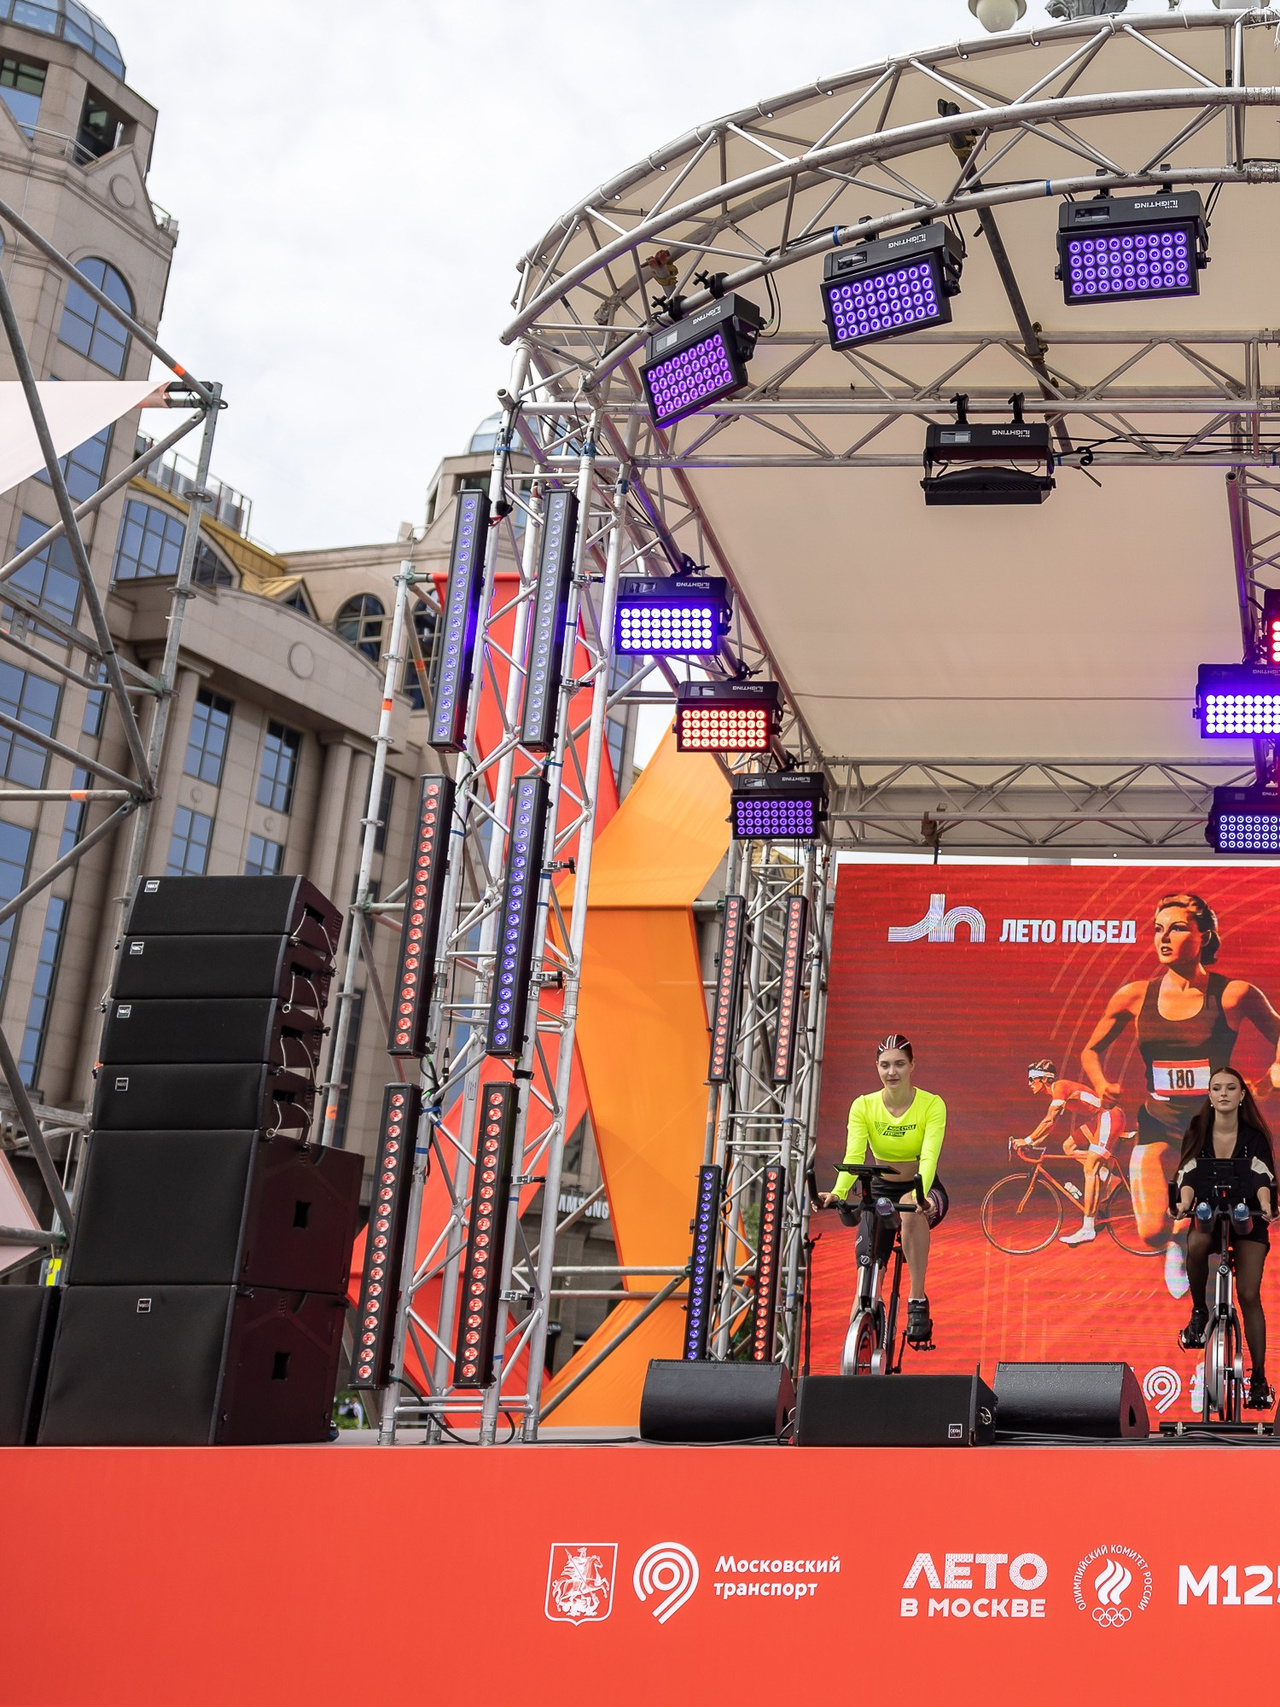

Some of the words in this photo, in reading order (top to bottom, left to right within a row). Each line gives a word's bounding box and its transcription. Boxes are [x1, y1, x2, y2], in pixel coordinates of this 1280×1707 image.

[998, 918, 1057, 944] ЛЕТО
[1061, 918, 1137, 944] ПОБЕД
[714, 1555, 841, 1573] Московский
[902, 1552, 1048, 1591] ЛЕТО
[1073, 1544, 1108, 1611] ОЛИМПИЙСКИЙ
[1110, 1544, 1148, 1570] КОМИТЕТ
[1137, 1571, 1153, 1611] РОССИИ
[714, 1582, 818, 1600] транспорт
[900, 1597, 918, 1618] В
[928, 1597, 1046, 1618] МОСКВЕ
